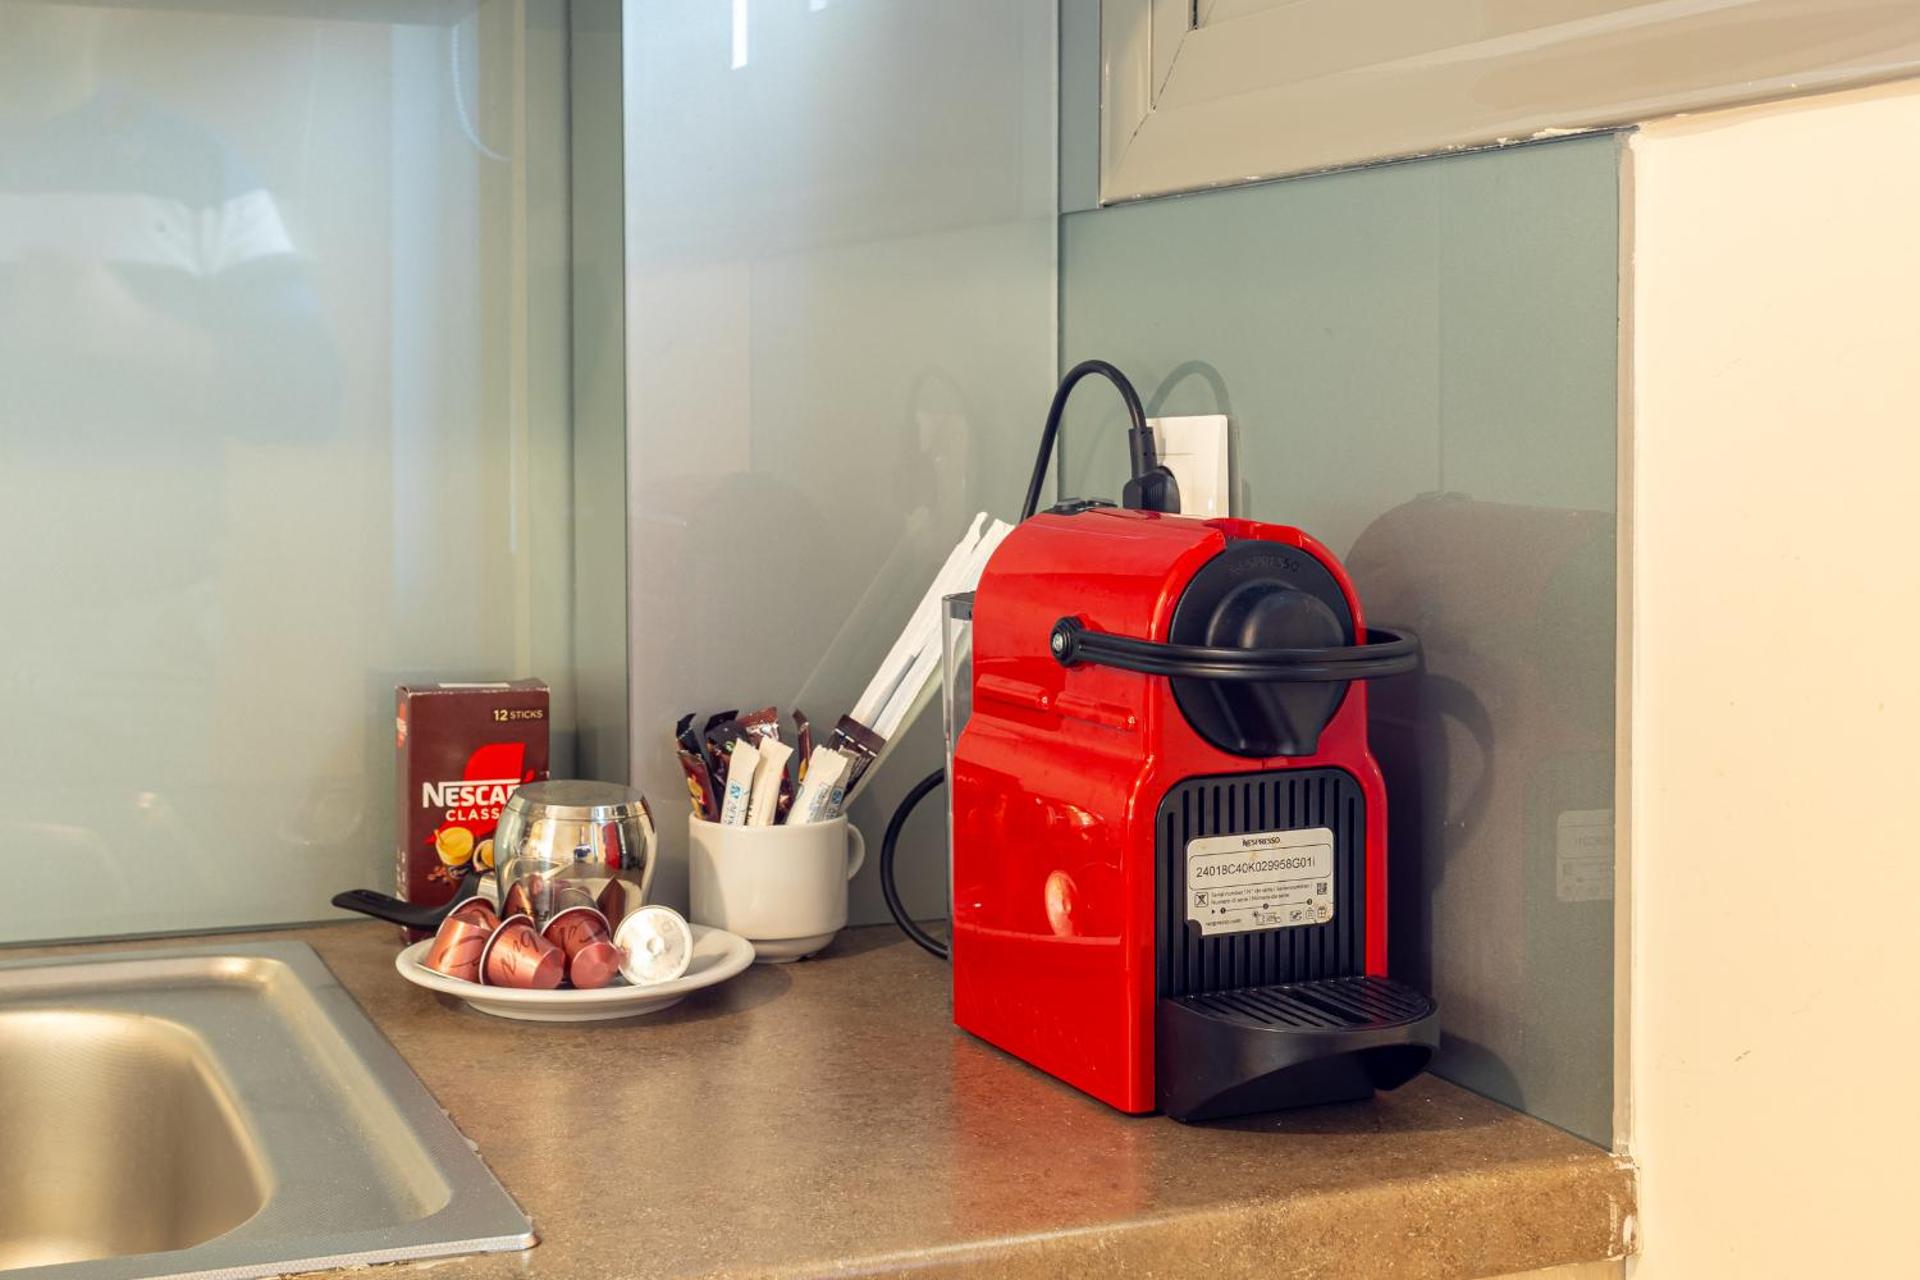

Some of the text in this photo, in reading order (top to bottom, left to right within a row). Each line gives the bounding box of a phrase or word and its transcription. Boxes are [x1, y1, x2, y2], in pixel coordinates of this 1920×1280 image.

[494, 709, 543, 721] 12 STICKS
[445, 808, 500, 822] CLASS
